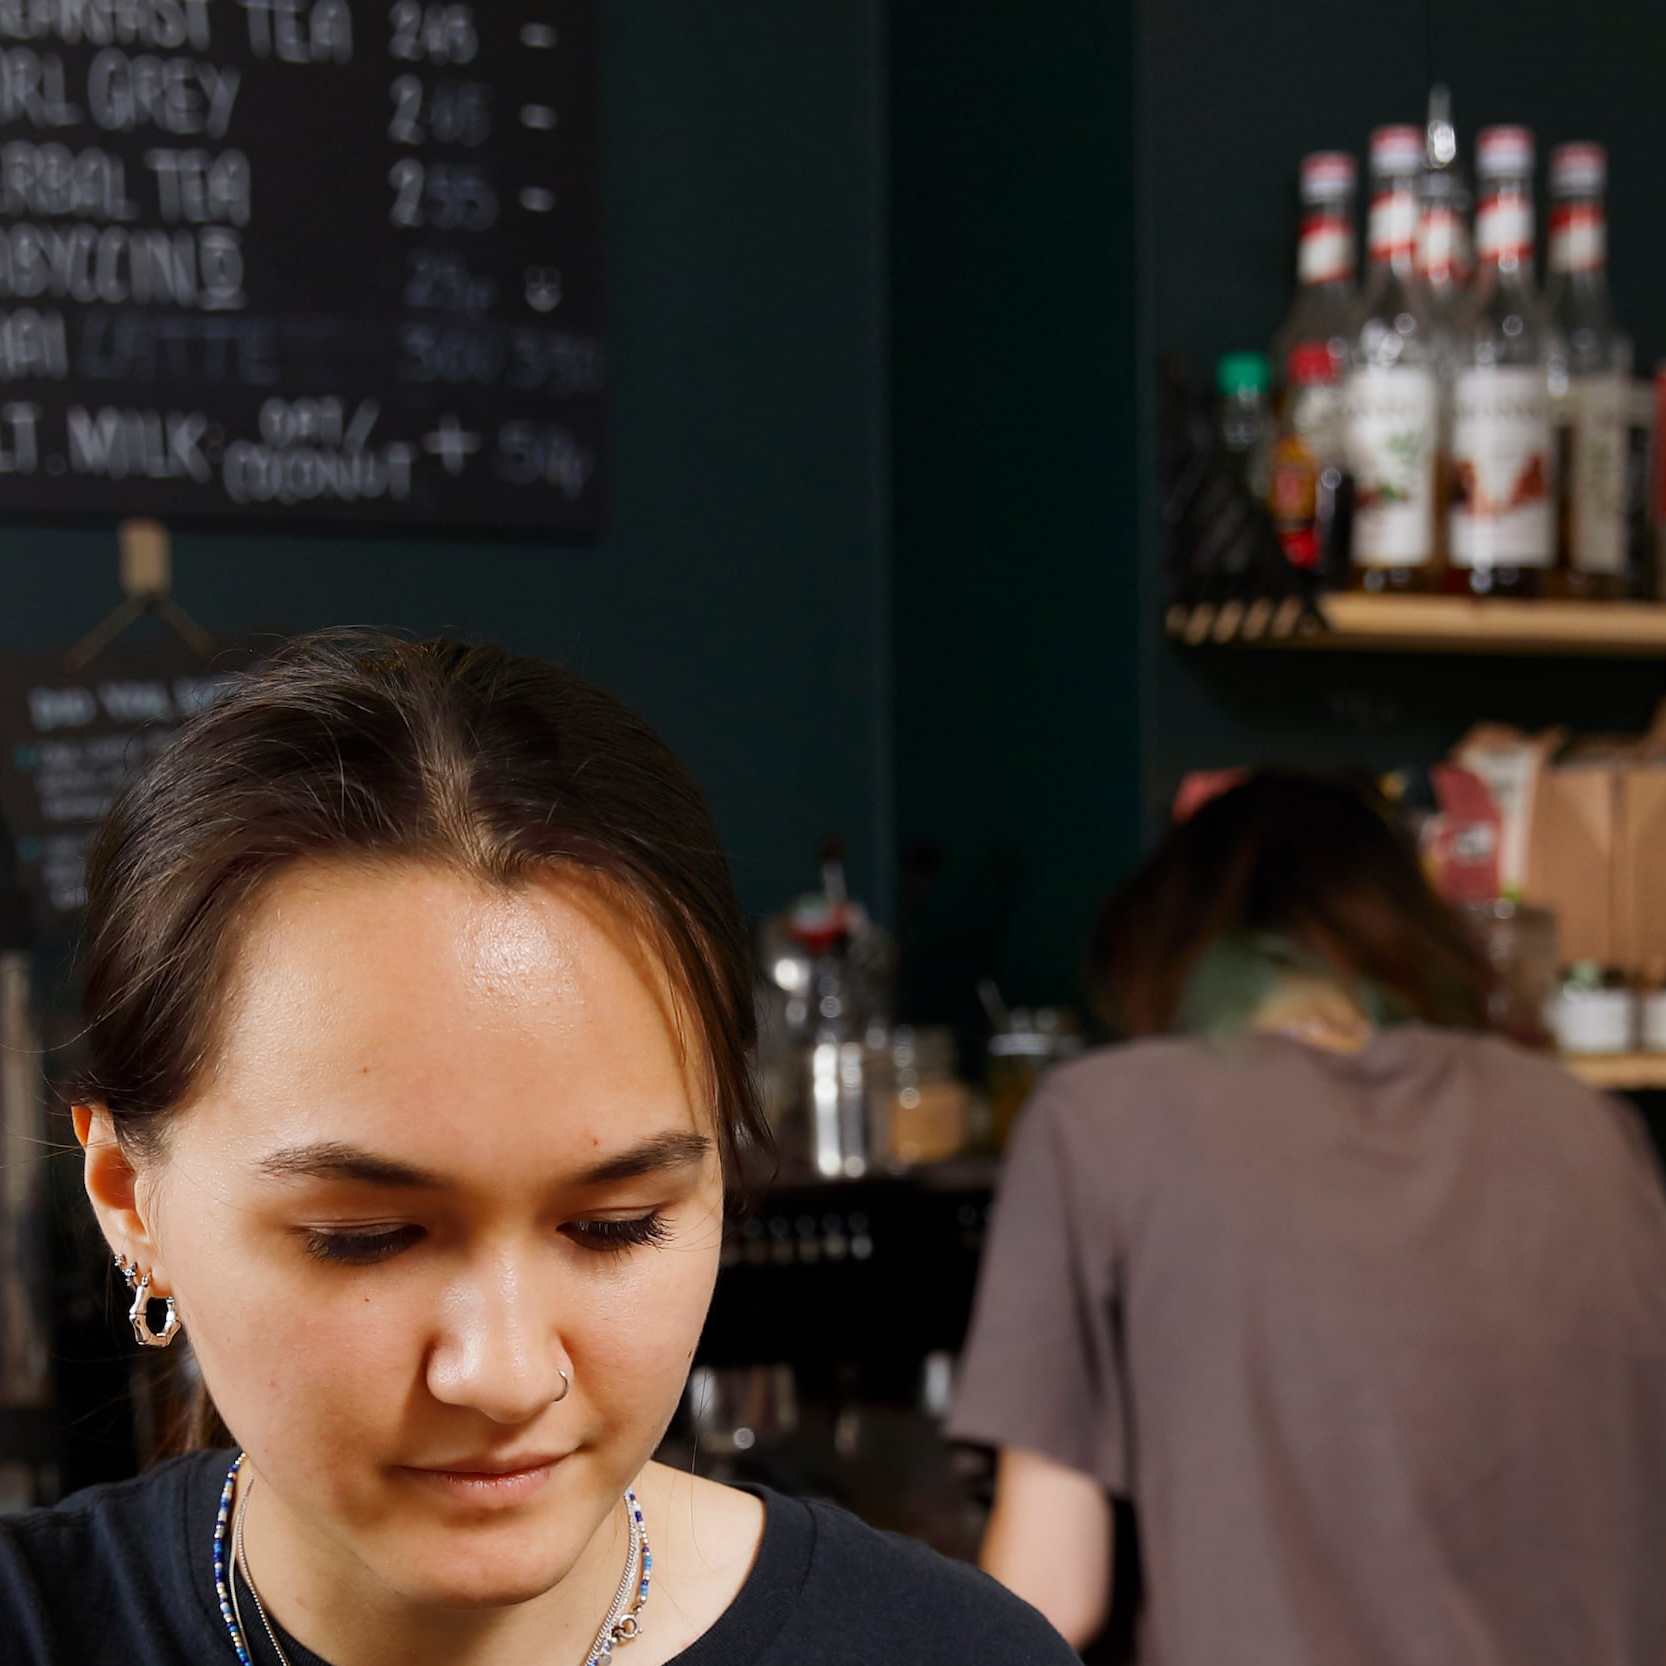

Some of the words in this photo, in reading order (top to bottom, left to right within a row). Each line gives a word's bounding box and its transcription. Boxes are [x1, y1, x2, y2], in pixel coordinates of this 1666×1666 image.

[237, 0, 354, 64] TEA
[87, 46, 242, 141] GREY
[141, 146, 251, 228] TEA
